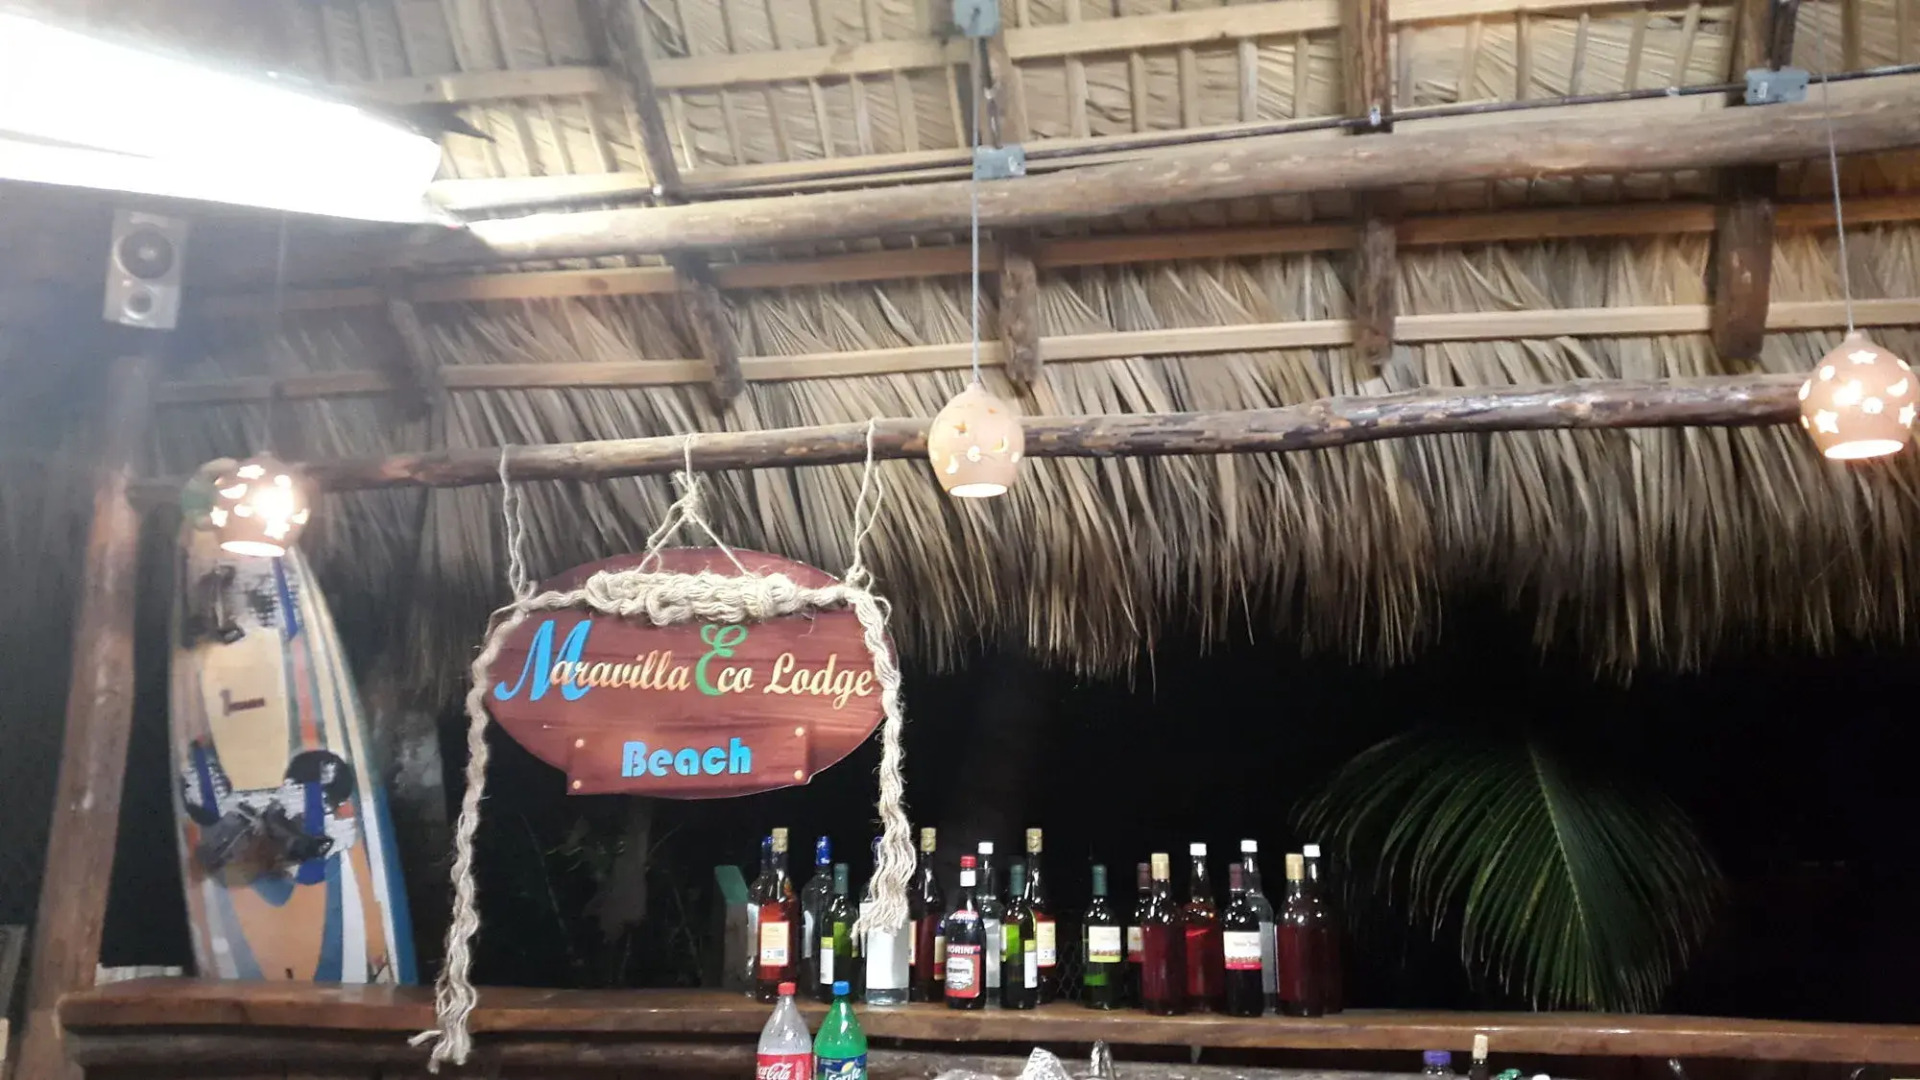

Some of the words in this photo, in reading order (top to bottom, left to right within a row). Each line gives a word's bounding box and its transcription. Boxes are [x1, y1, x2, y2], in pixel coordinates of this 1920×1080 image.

[494, 620, 690, 701] Maravilla
[695, 624, 754, 696] Eco
[763, 652, 873, 710] Lodge
[621, 737, 752, 777] Beach
